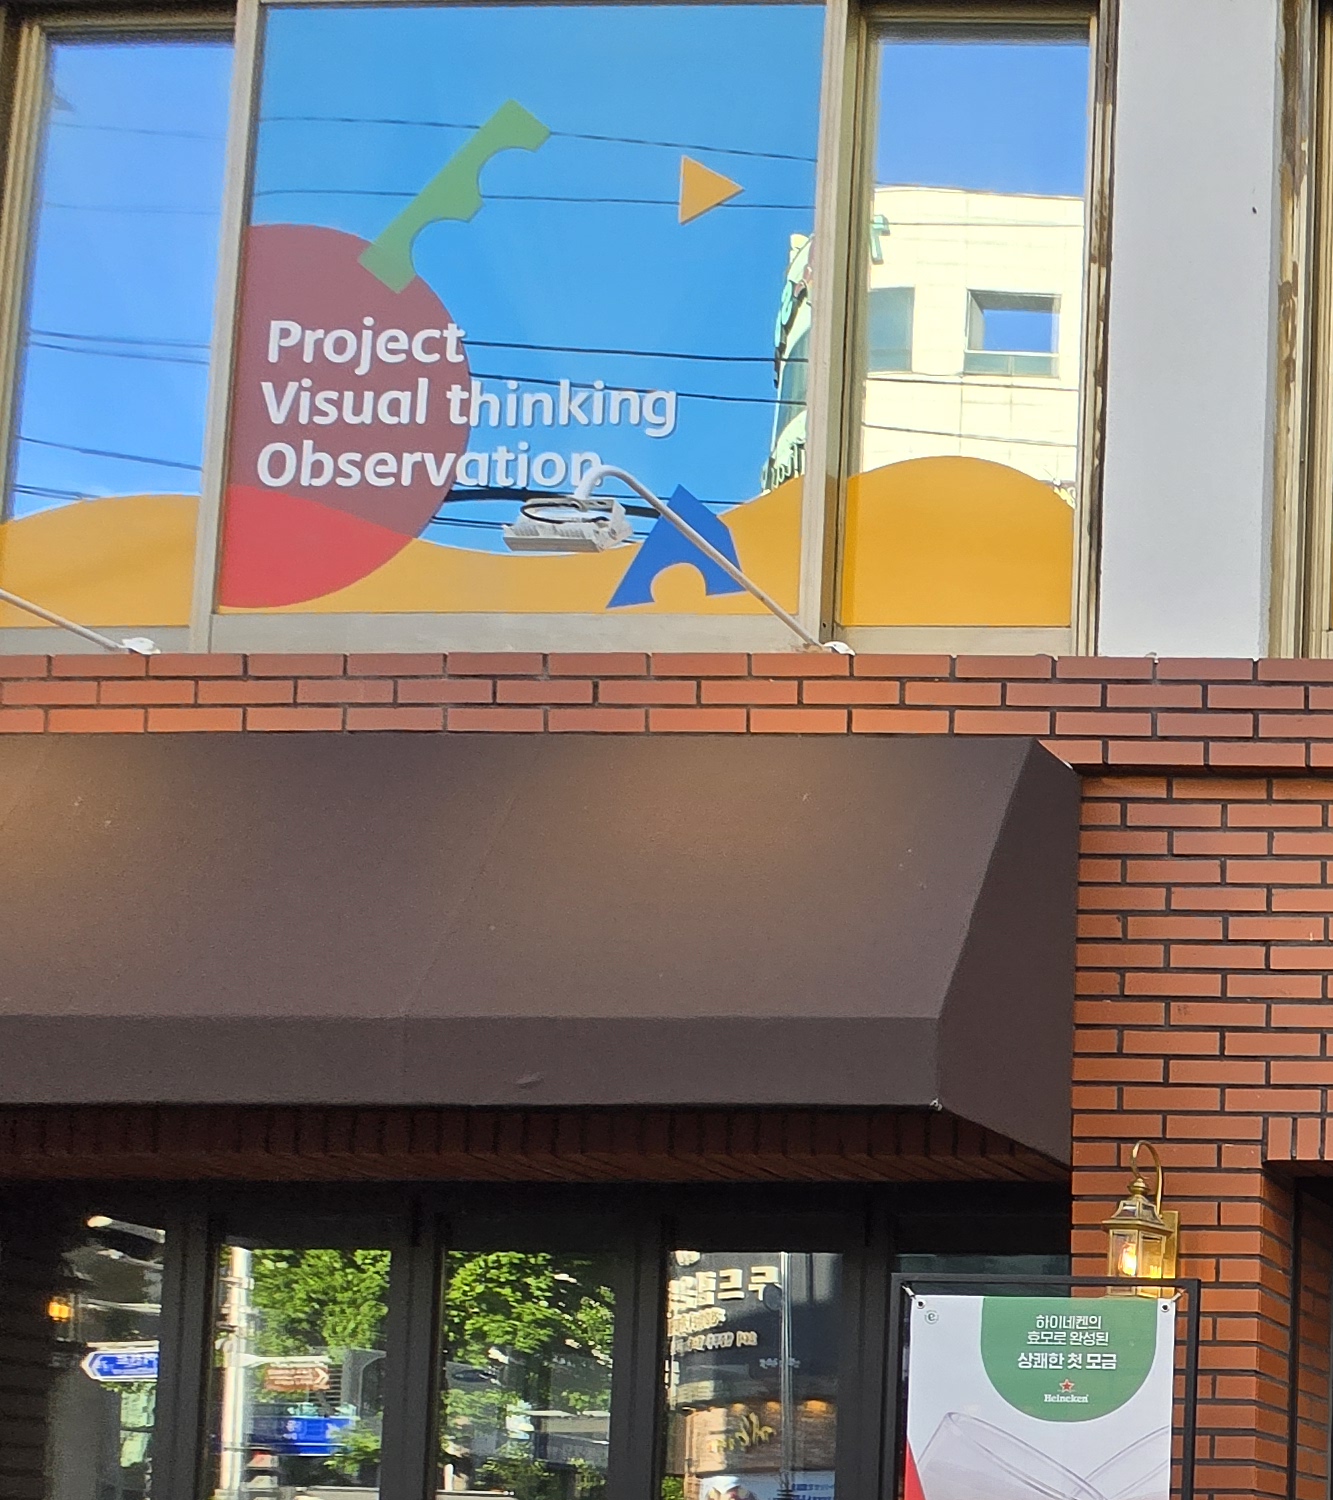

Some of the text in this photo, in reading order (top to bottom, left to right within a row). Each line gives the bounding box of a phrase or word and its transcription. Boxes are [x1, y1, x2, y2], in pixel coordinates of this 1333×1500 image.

[267, 317, 466, 375] Project
[260, 379, 679, 438] Visual thinking
[256, 440, 605, 489] Observation
[1036, 1315, 1102, 1330] 하이네켄의
[1027, 1331, 1109, 1346] 효모로 완성된
[1017, 1352, 1117, 1370] 상쾌한 첫 모금
[1044, 1394, 1089, 1404] Heineken
